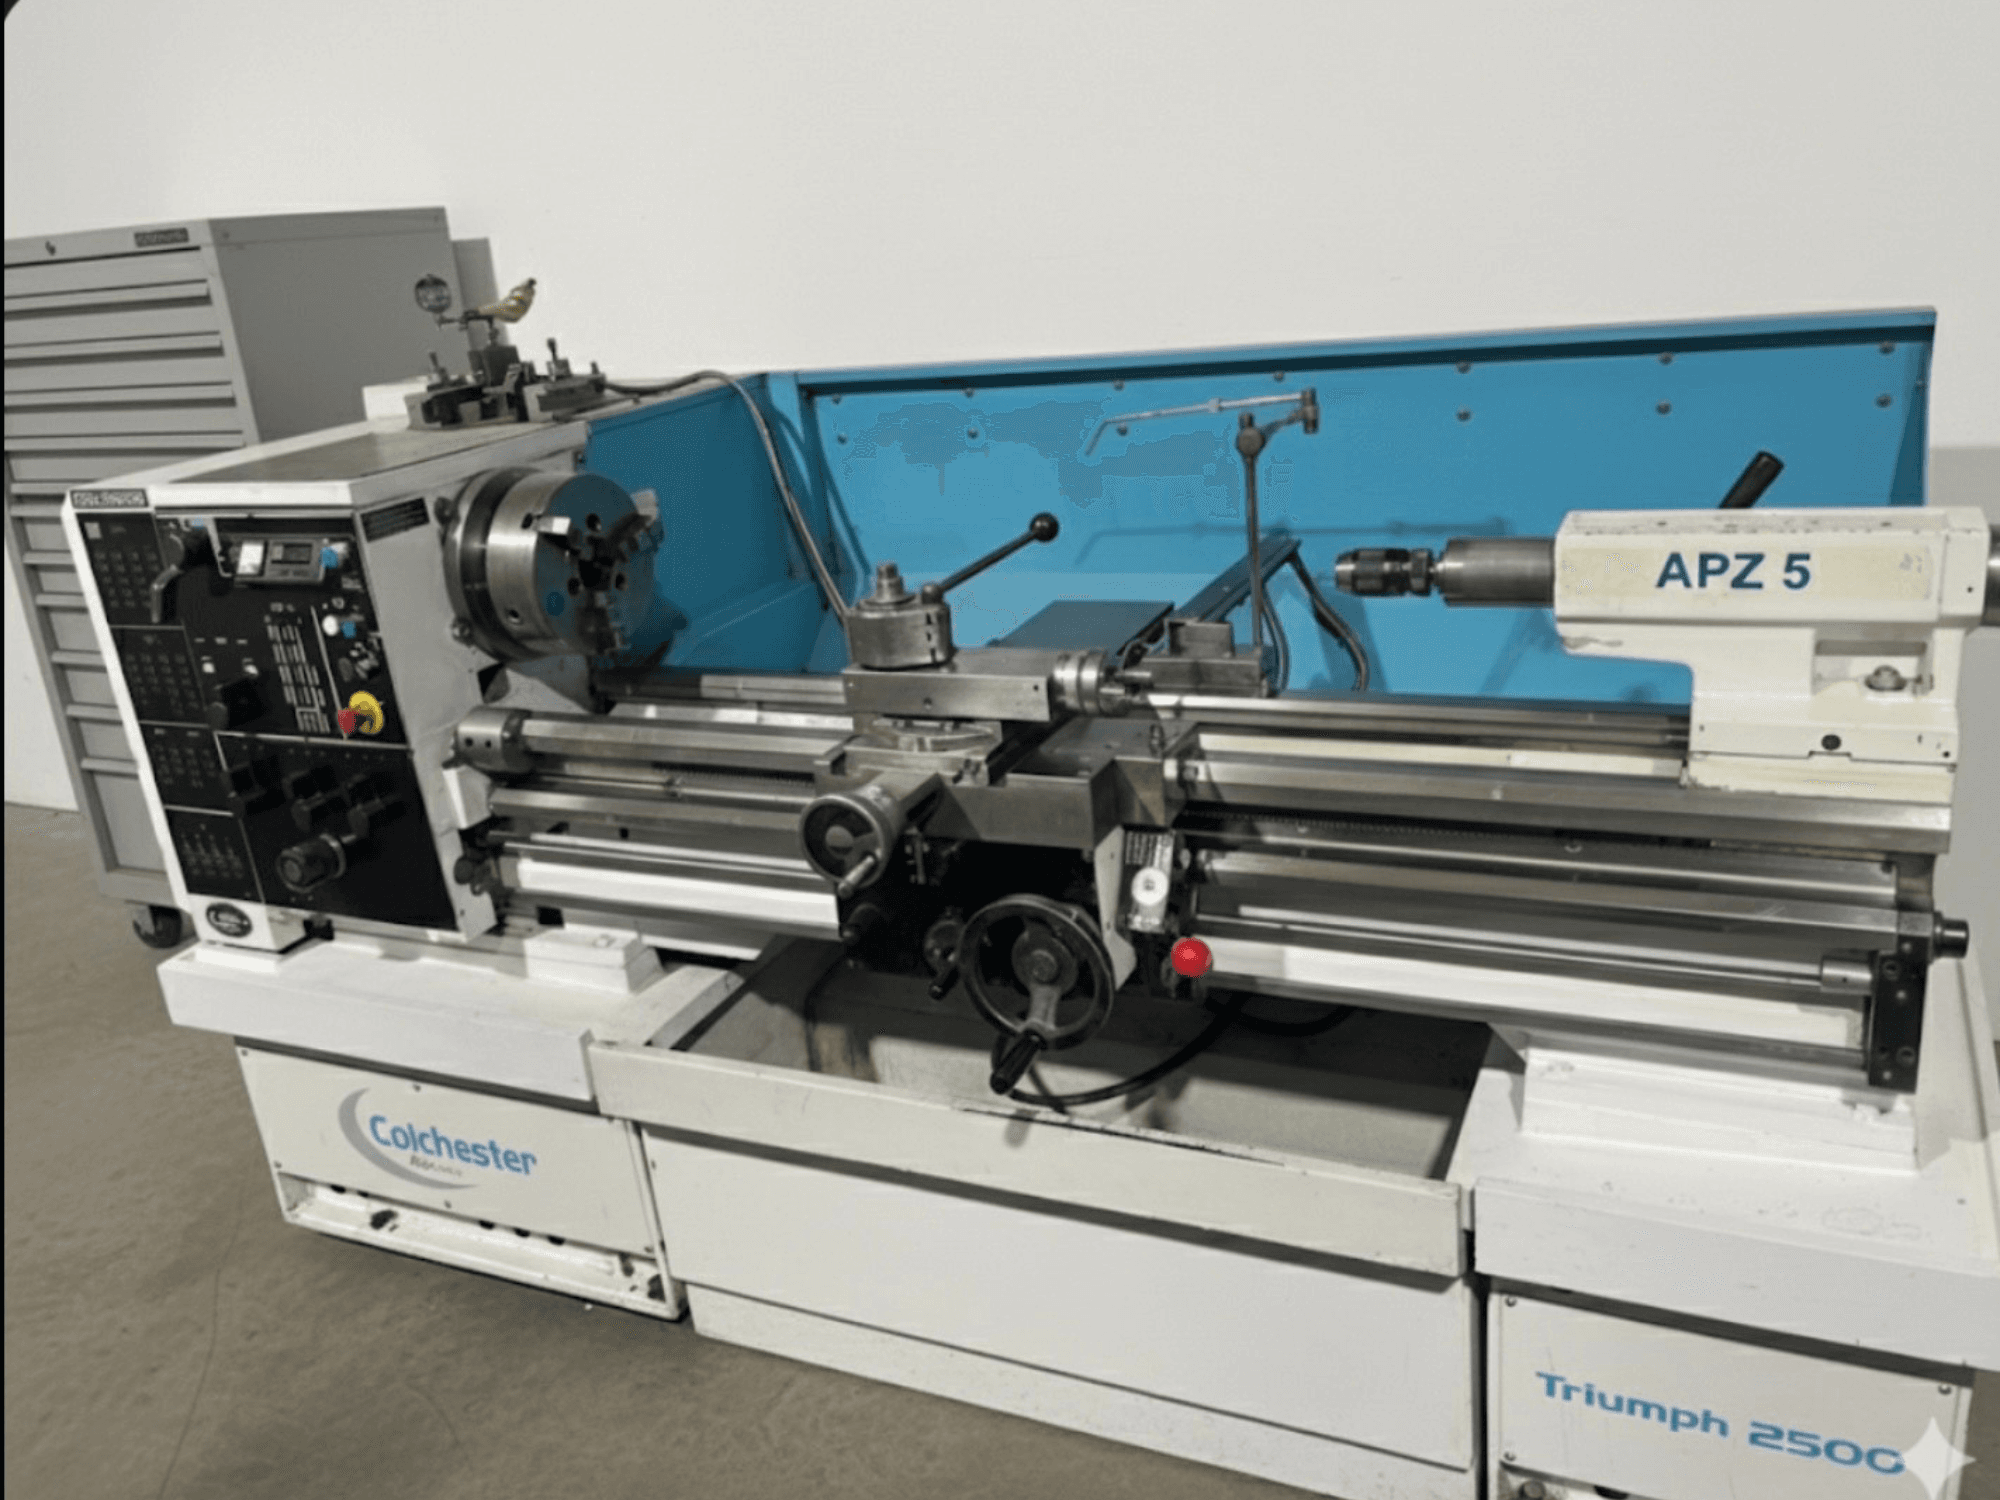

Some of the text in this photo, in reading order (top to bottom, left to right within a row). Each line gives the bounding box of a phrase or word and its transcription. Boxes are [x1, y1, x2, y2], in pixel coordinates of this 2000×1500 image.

[1656, 552, 1812, 590] APZ 5
[369, 1114, 537, 1176] Colchester
[1536, 1370, 1730, 1439] Triumph
